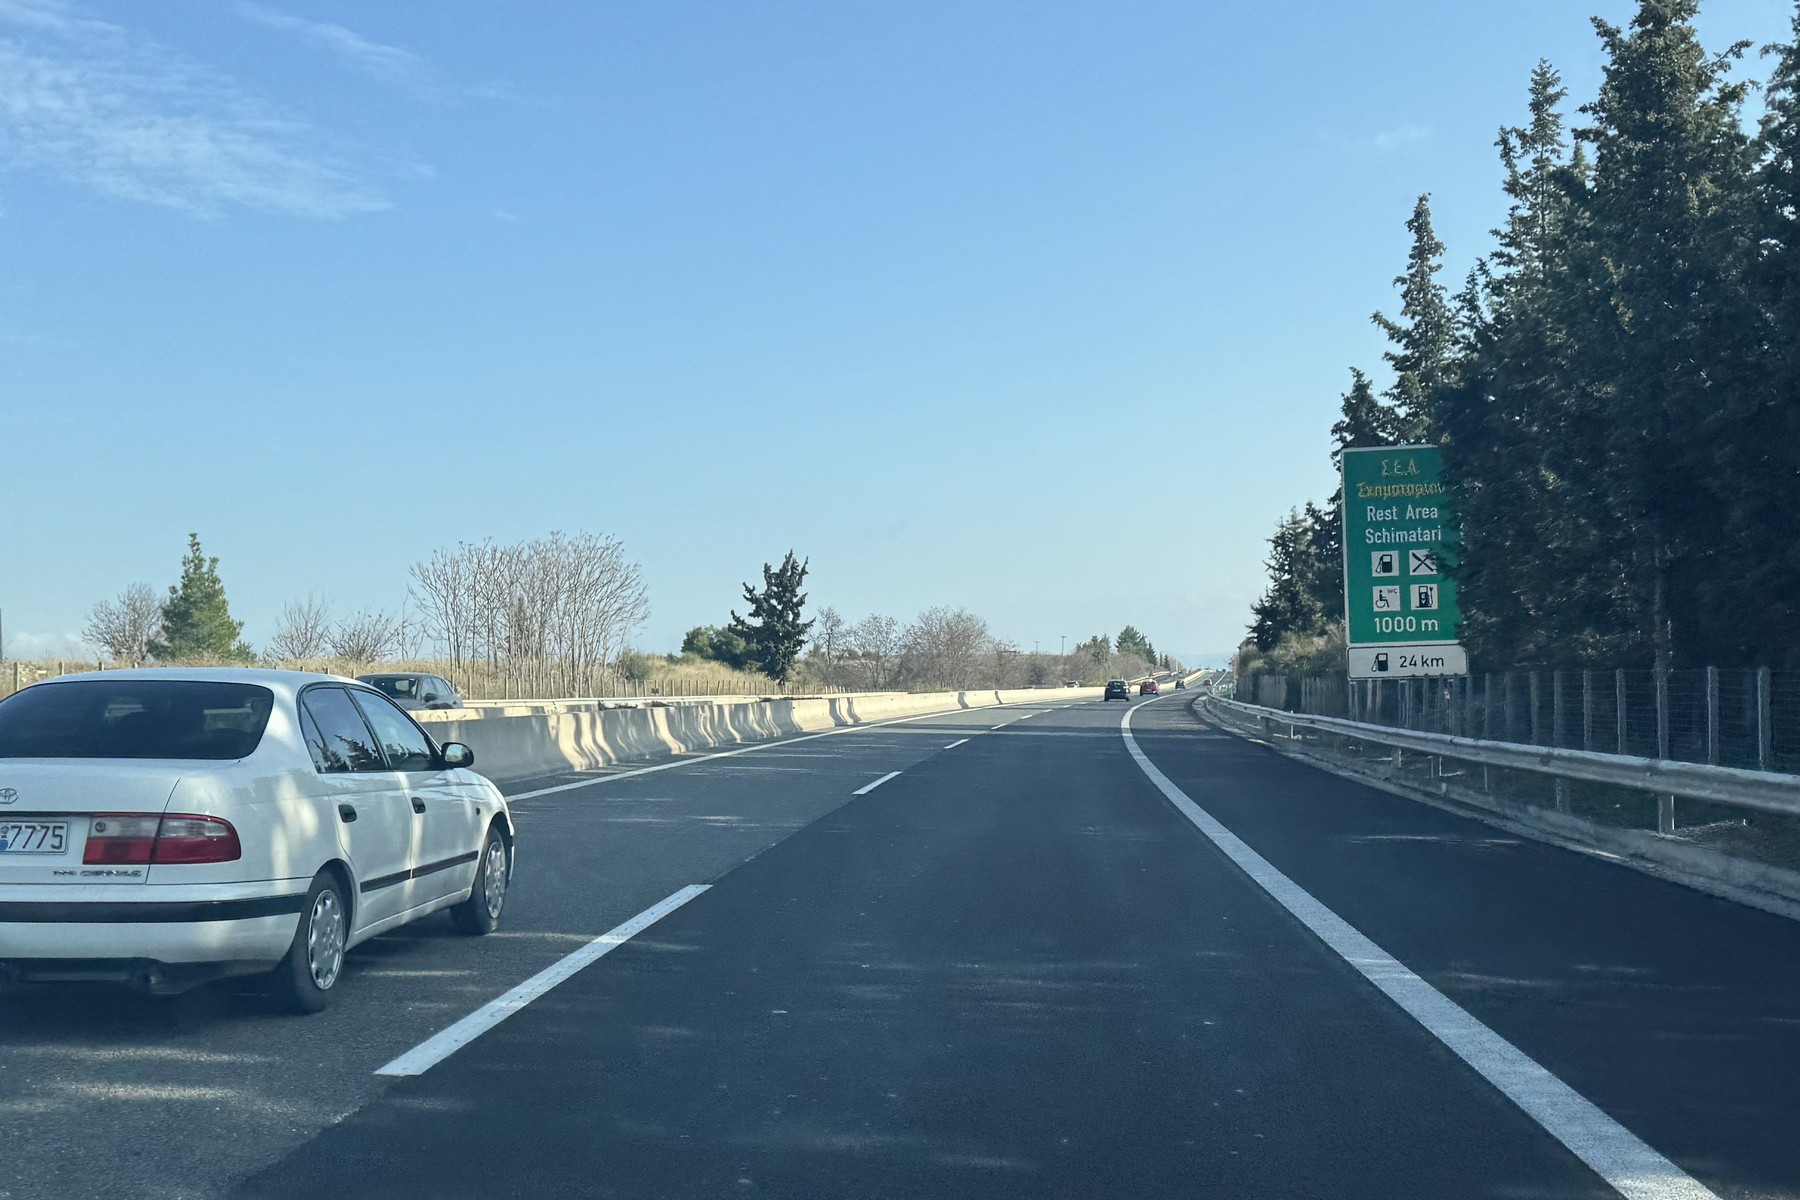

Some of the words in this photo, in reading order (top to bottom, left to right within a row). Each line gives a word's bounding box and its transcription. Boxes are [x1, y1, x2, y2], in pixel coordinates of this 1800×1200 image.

[1367, 505, 1398, 521] Rest
[1405, 504, 1438, 520] Area
[1365, 525, 1441, 544] Schimatari
[1373, 616, 1416, 633] 1000
[1421, 619, 1438, 631] m
[9, 825, 65, 849] 7775
